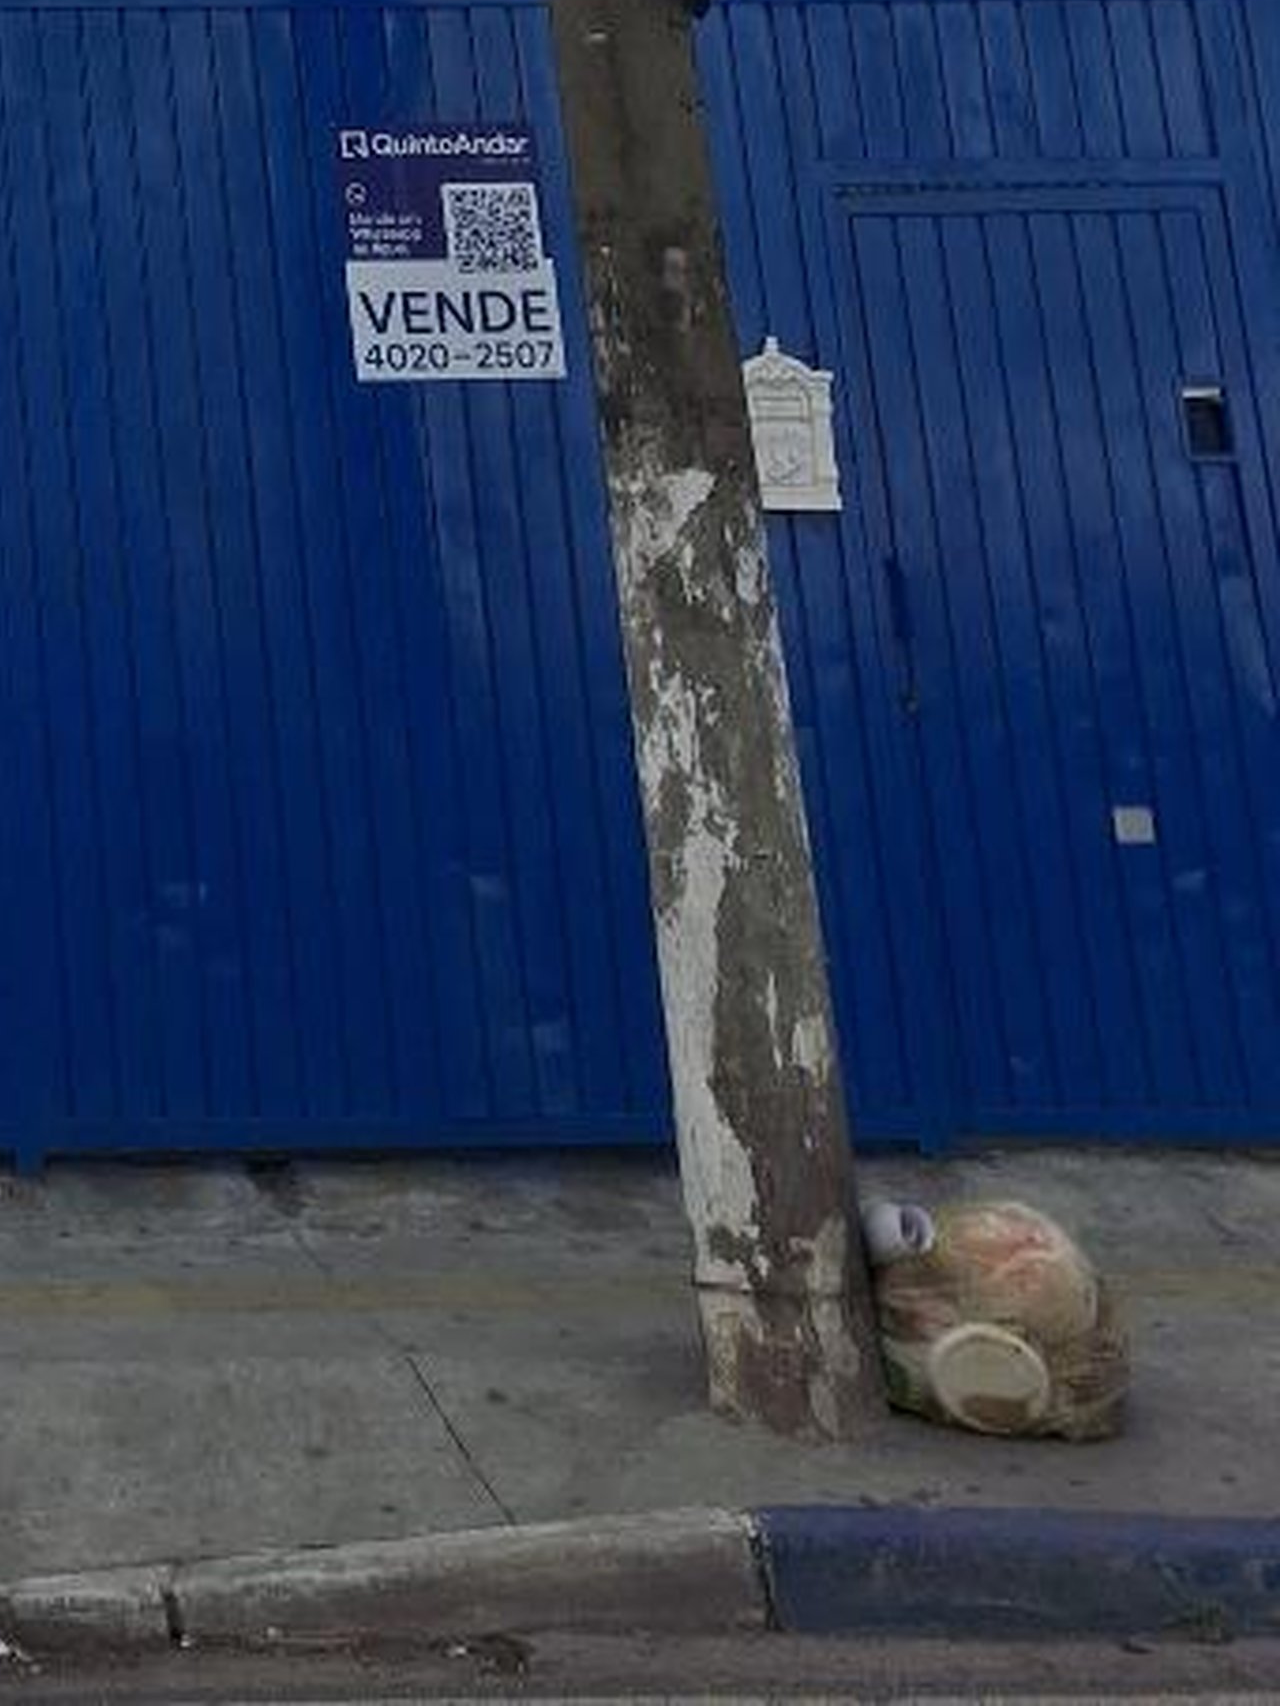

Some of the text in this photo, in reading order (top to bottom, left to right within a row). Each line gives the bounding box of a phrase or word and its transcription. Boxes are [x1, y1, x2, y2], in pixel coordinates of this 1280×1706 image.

[372, 133, 530, 158] QuintoAndar
[359, 290, 553, 335] VENDE
[364, 342, 555, 372] 4020-2507
